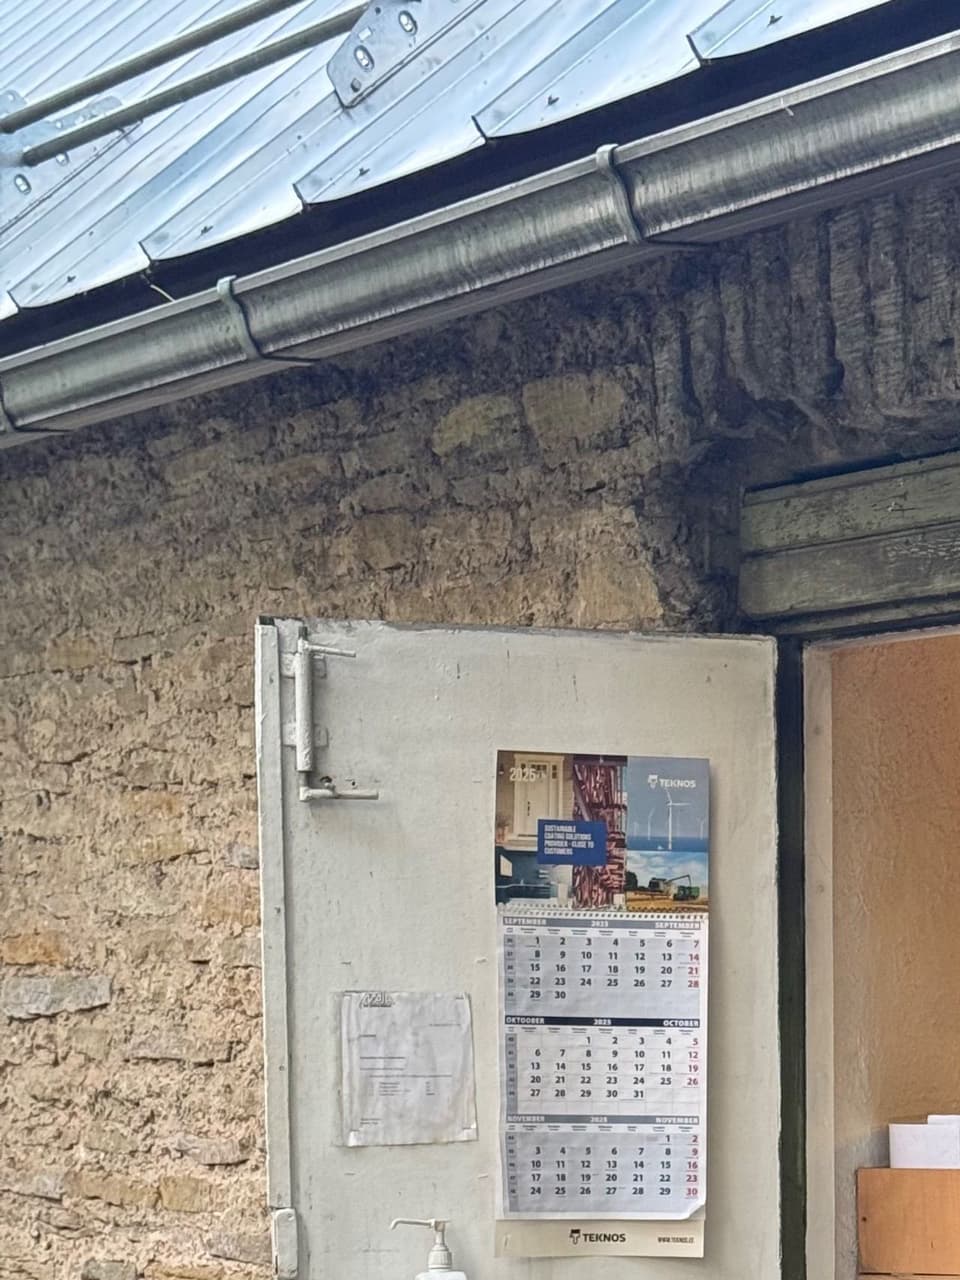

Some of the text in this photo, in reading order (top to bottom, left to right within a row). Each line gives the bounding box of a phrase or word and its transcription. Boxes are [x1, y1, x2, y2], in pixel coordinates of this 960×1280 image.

[660, 778, 696, 788] TEKNOS
[504, 917, 547, 925] SEPTEMBER
[560, 937, 565, 945] 2
[586, 938, 592, 946] 3
[613, 938, 618, 946] 4
[640, 939, 645, 947] 5
[666, 940, 672, 948] 6
[694, 940, 699, 948] 7
[535, 950, 540, 958] 8
[560, 951, 566, 959] 9
[581, 951, 592, 959] 10
[609, 952, 617, 960] 11
[662, 953, 672, 961] 13
[530, 963, 698, 975] 15 16 17 18 19 20 21
[530, 977, 540, 985] 22
[555, 977, 566, 985] 23
[580, 978, 591, 986] 24
[607, 979, 618, 987] 25
[634, 979, 645, 987] 26
[688, 980, 699, 988] 28
[530, 990, 566, 999] 29 30
[506, 1017, 545, 1025] OKTOOBER
[640, 1037, 644, 1045] 3
[693, 1038, 698, 1046] 5
[560, 1049, 565, 1057] 7
[635, 1050, 645, 1058] 10
[689, 1051, 698, 1059] 12
[531, 1062, 540, 1070] 13
[581, 1063, 591, 1071] 15
[661, 1064, 672, 1072] 18
[689, 1064, 698, 1072] 19
[530, 1075, 541, 1083] 20
[555, 1076, 565, 1084] 21
[580, 1076, 591, 1084] 22
[606, 1076, 617, 1084] 23
[660, 1077, 671, 1085] 25
[530, 1089, 643, 1098] 27 28 29 30 31
[692, 1135, 698, 1143] 2
[536, 1146, 541, 1155] 3
[586, 1147, 591, 1155] 5
[611, 1147, 617, 1155] 6
[638, 1147, 644, 1155] 7
[665, 1148, 671, 1156] 8
[692, 1148, 698, 1156] 9
[531, 1160, 541, 1168] 10
[556, 1160, 565, 1168] 11
[581, 1160, 591, 1168] 12
[607, 1160, 617, 1168] 13
[661, 1161, 671, 1169] 15
[688, 1161, 698, 1169] 16
[531, 1173, 541, 1181] 17
[633, 1174, 643, 1182] 21
[660, 1174, 670, 1182] 22
[531, 1187, 698, 1196] 24 25 26 27 28 29 30
[583, 1233, 626, 1243] TEKNOS
